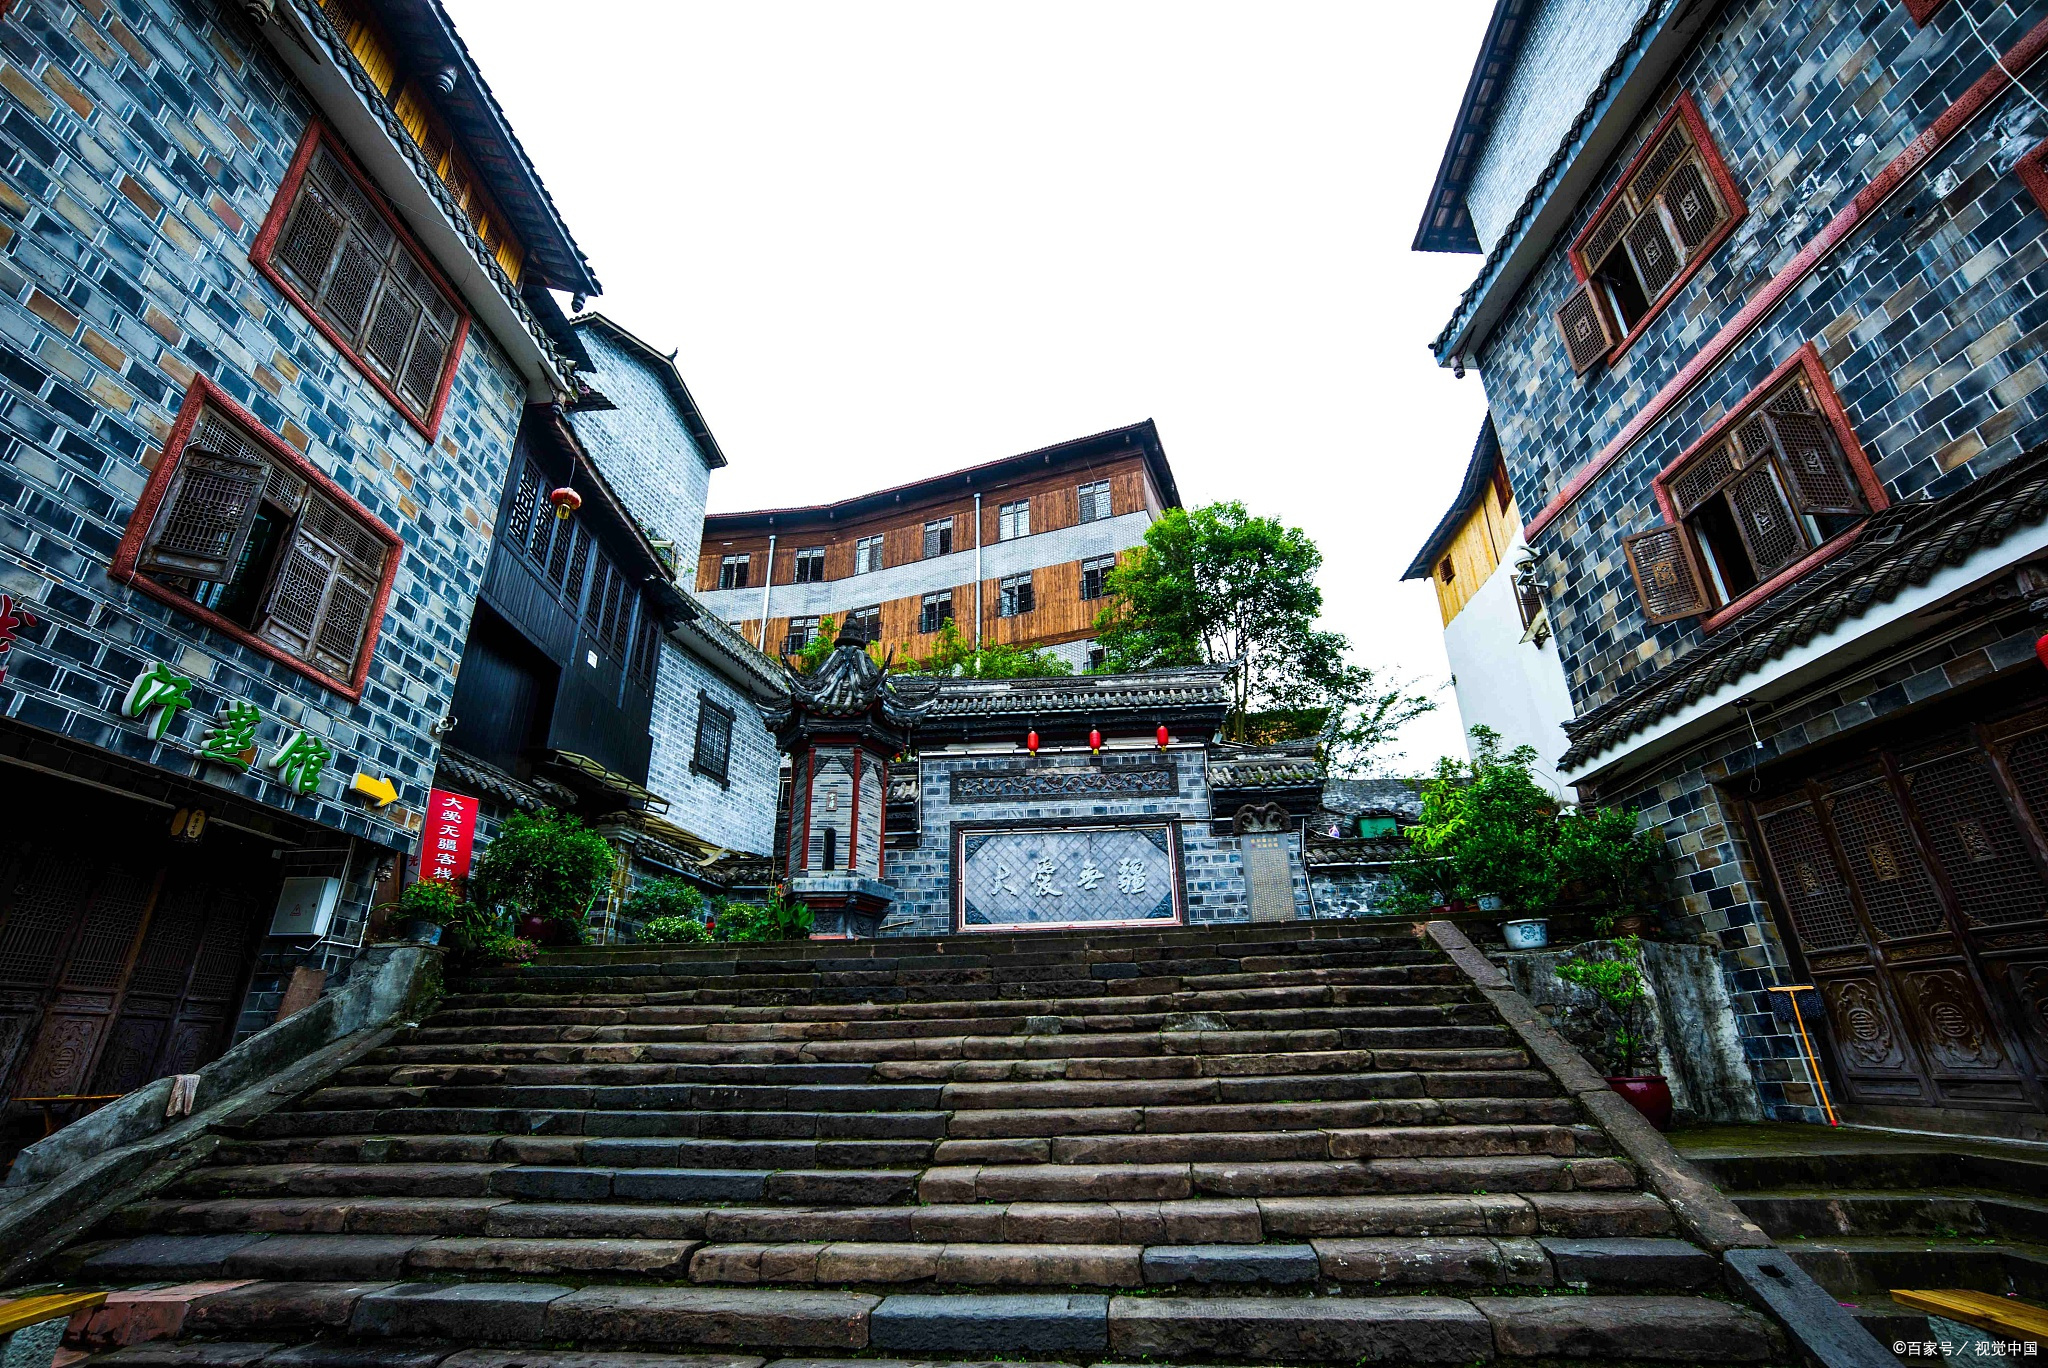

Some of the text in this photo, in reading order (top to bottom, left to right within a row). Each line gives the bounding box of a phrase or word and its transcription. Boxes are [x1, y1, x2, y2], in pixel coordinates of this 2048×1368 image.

[121, 661, 332, 795] 汗蒸馆
[432, 797, 465, 881] 大爱无疆客栈
